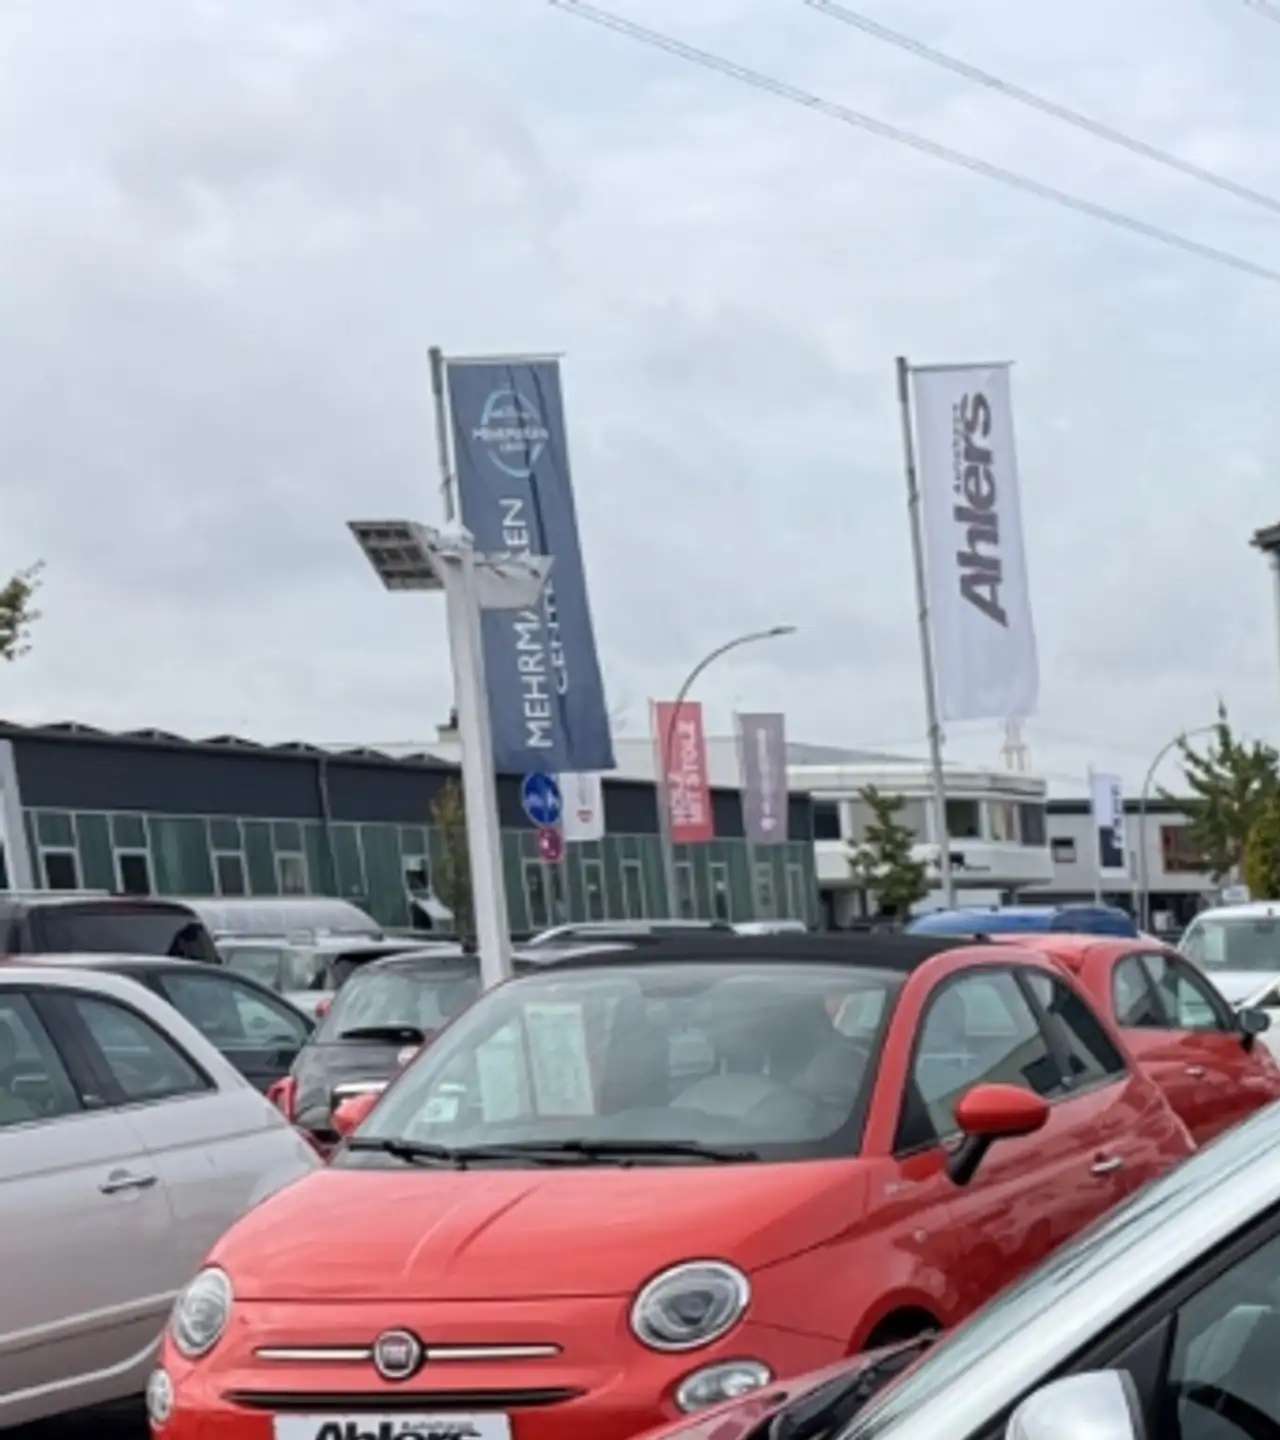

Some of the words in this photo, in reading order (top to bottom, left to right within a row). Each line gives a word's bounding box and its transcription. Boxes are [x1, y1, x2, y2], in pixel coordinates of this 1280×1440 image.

[499, 498, 554, 748] MEHRMEN
[953, 392, 1009, 628] Ahlers
[543, 577, 569, 695] CENTE
